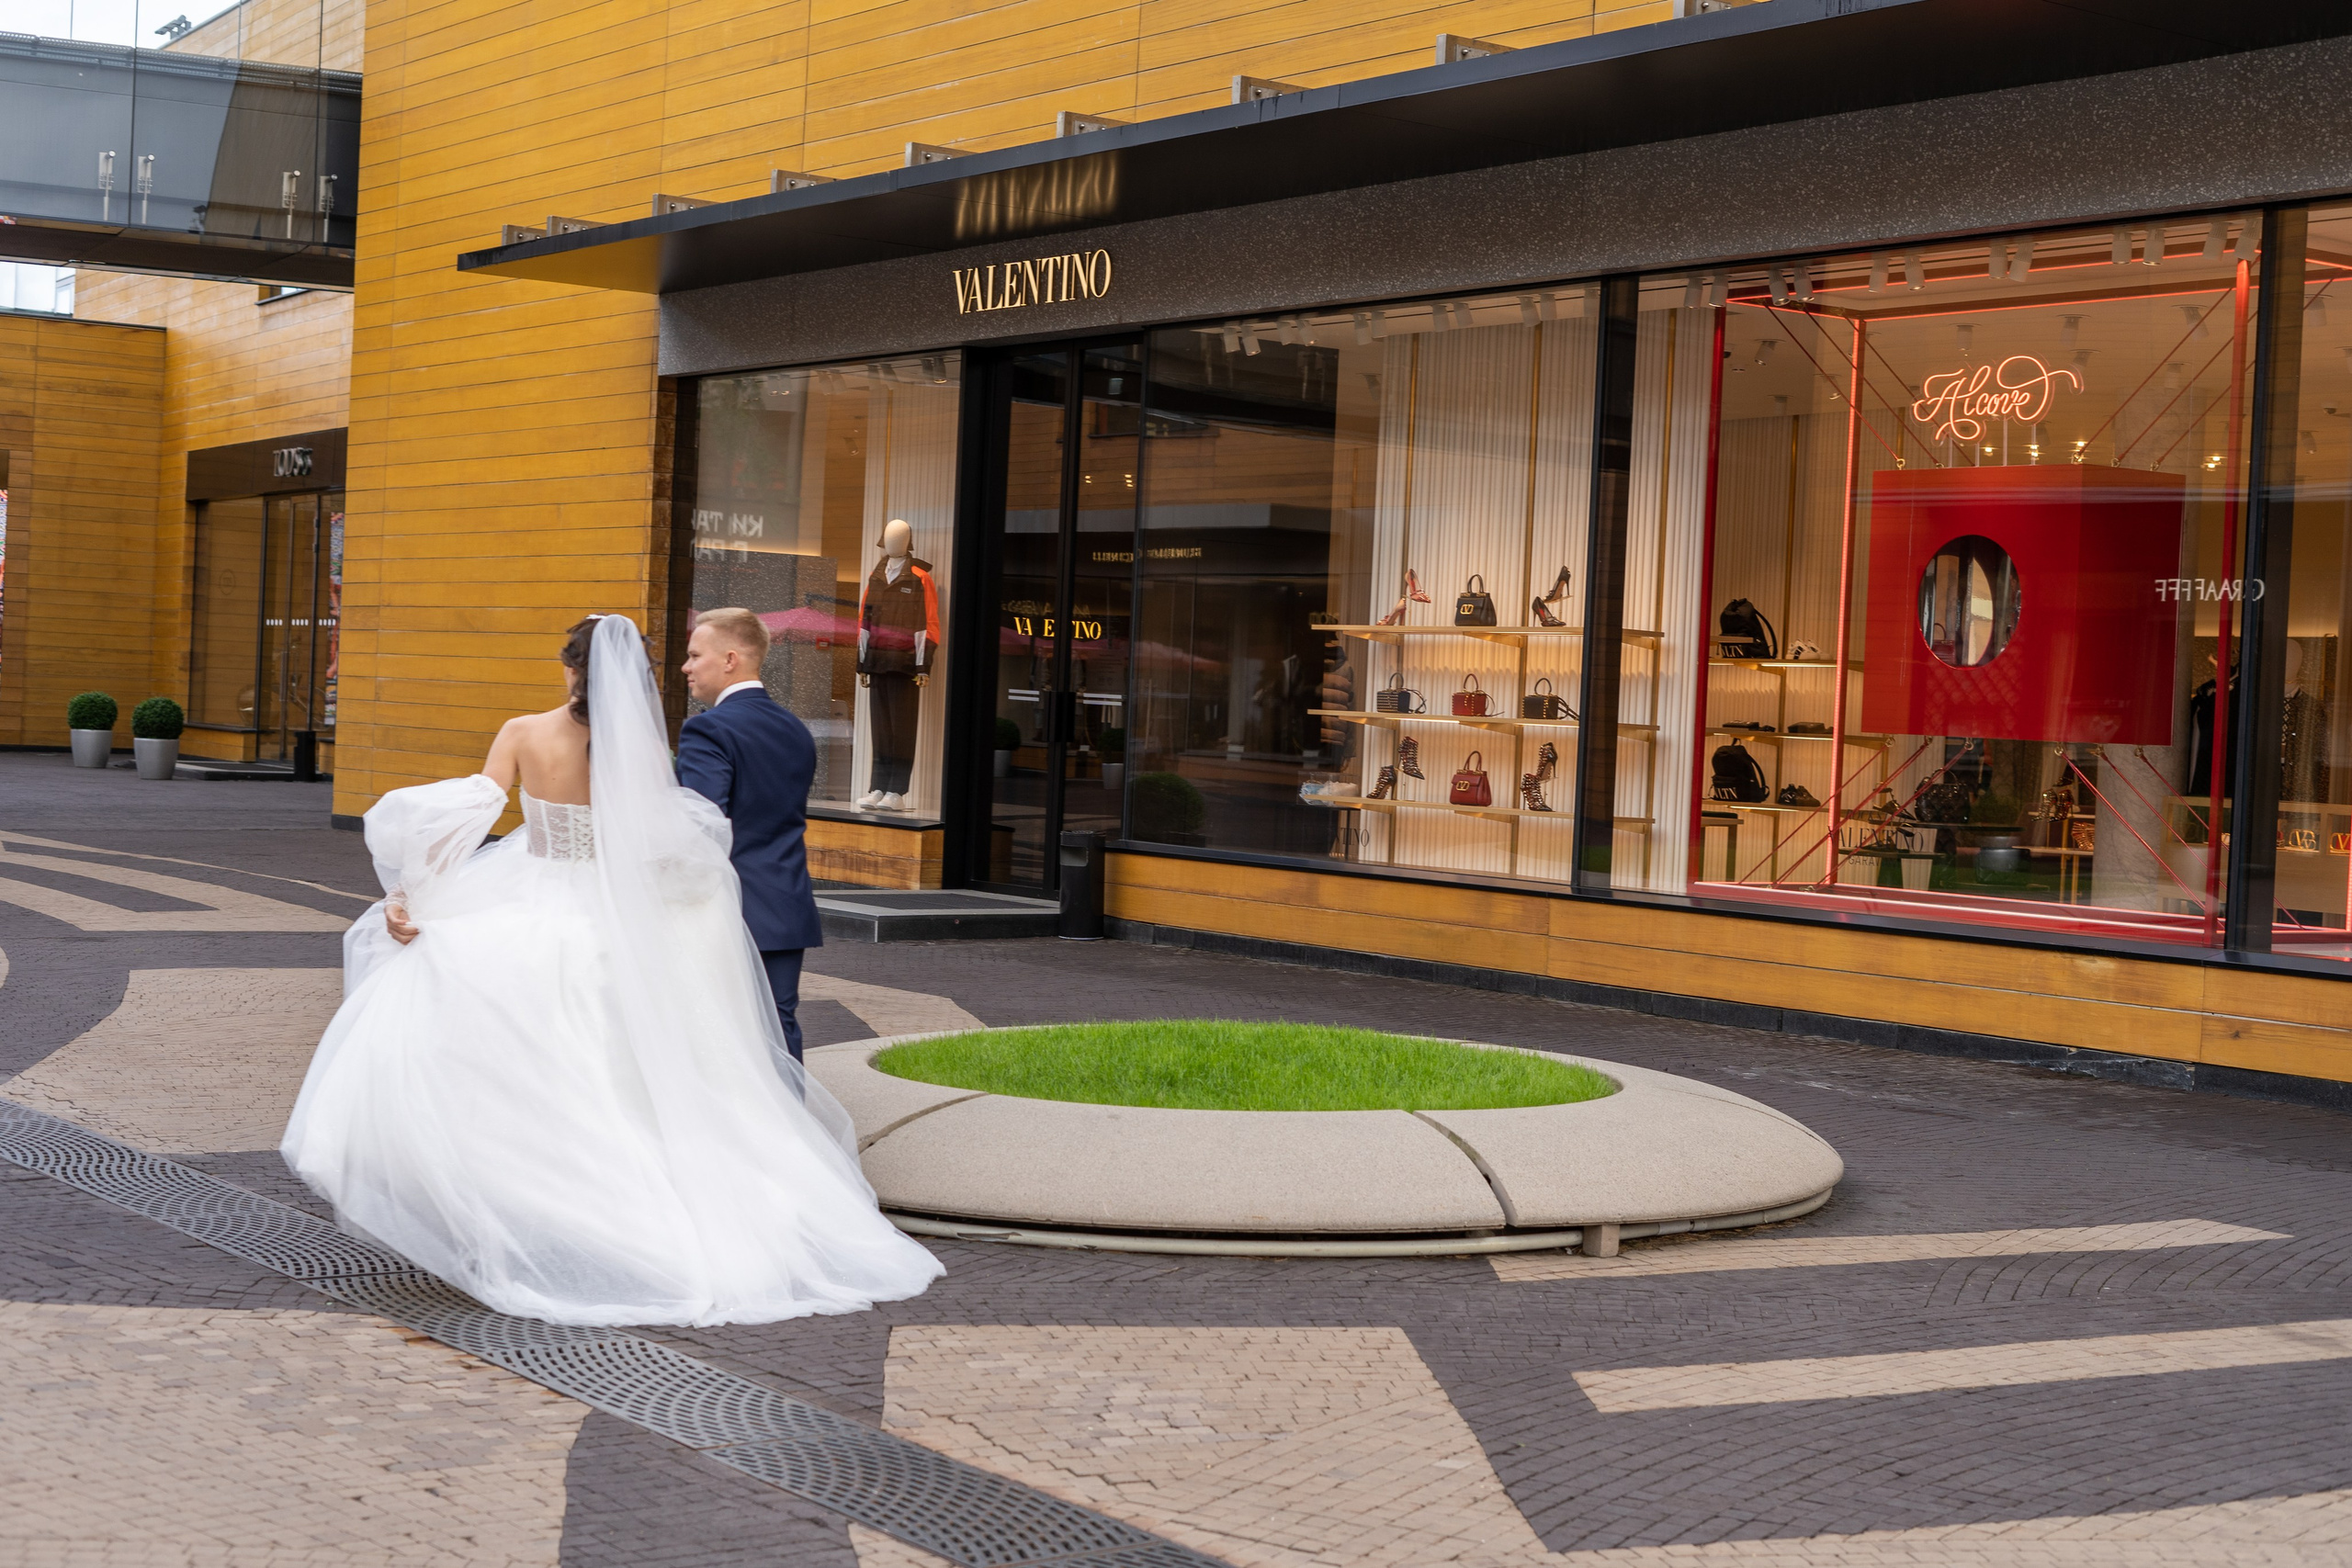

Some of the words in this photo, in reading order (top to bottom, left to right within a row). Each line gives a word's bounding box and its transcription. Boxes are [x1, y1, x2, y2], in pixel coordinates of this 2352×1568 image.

[952, 249, 1112, 314] VALENTINO
[1913, 355, 2080, 440] Alcove
[1013, 616, 1102, 640] VAEINO
